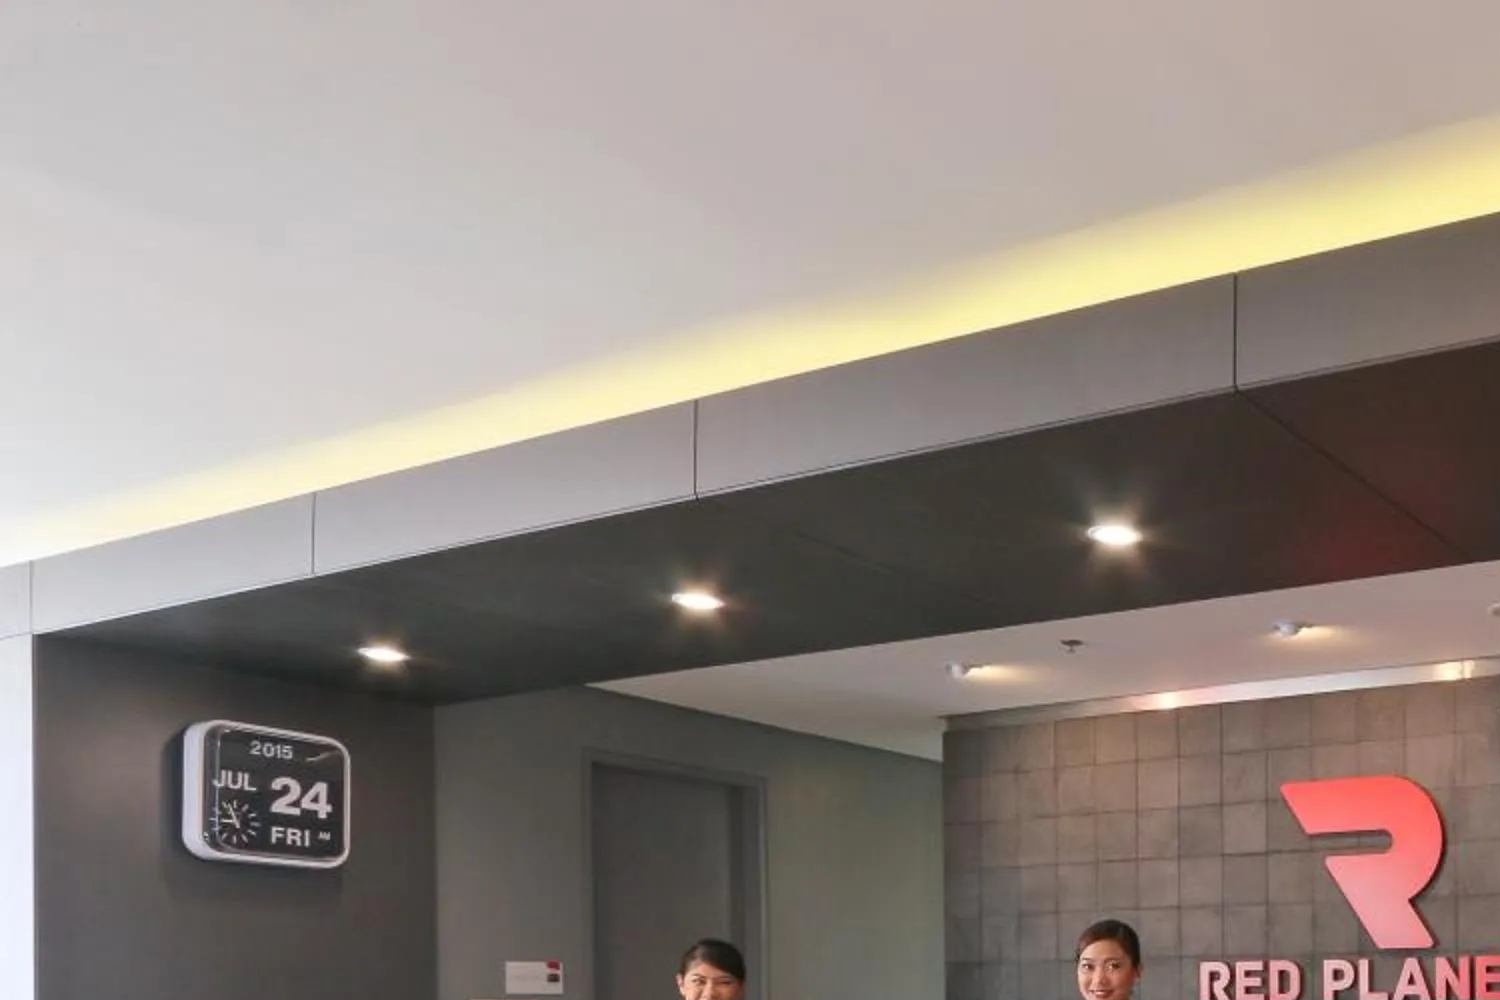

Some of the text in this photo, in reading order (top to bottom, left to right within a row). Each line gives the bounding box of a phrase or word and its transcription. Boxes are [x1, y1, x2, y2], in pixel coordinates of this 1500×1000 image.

[250, 740, 294, 760] 2015
[213, 769, 333, 819] JUL 24
[270, 826, 311, 848] FRI
